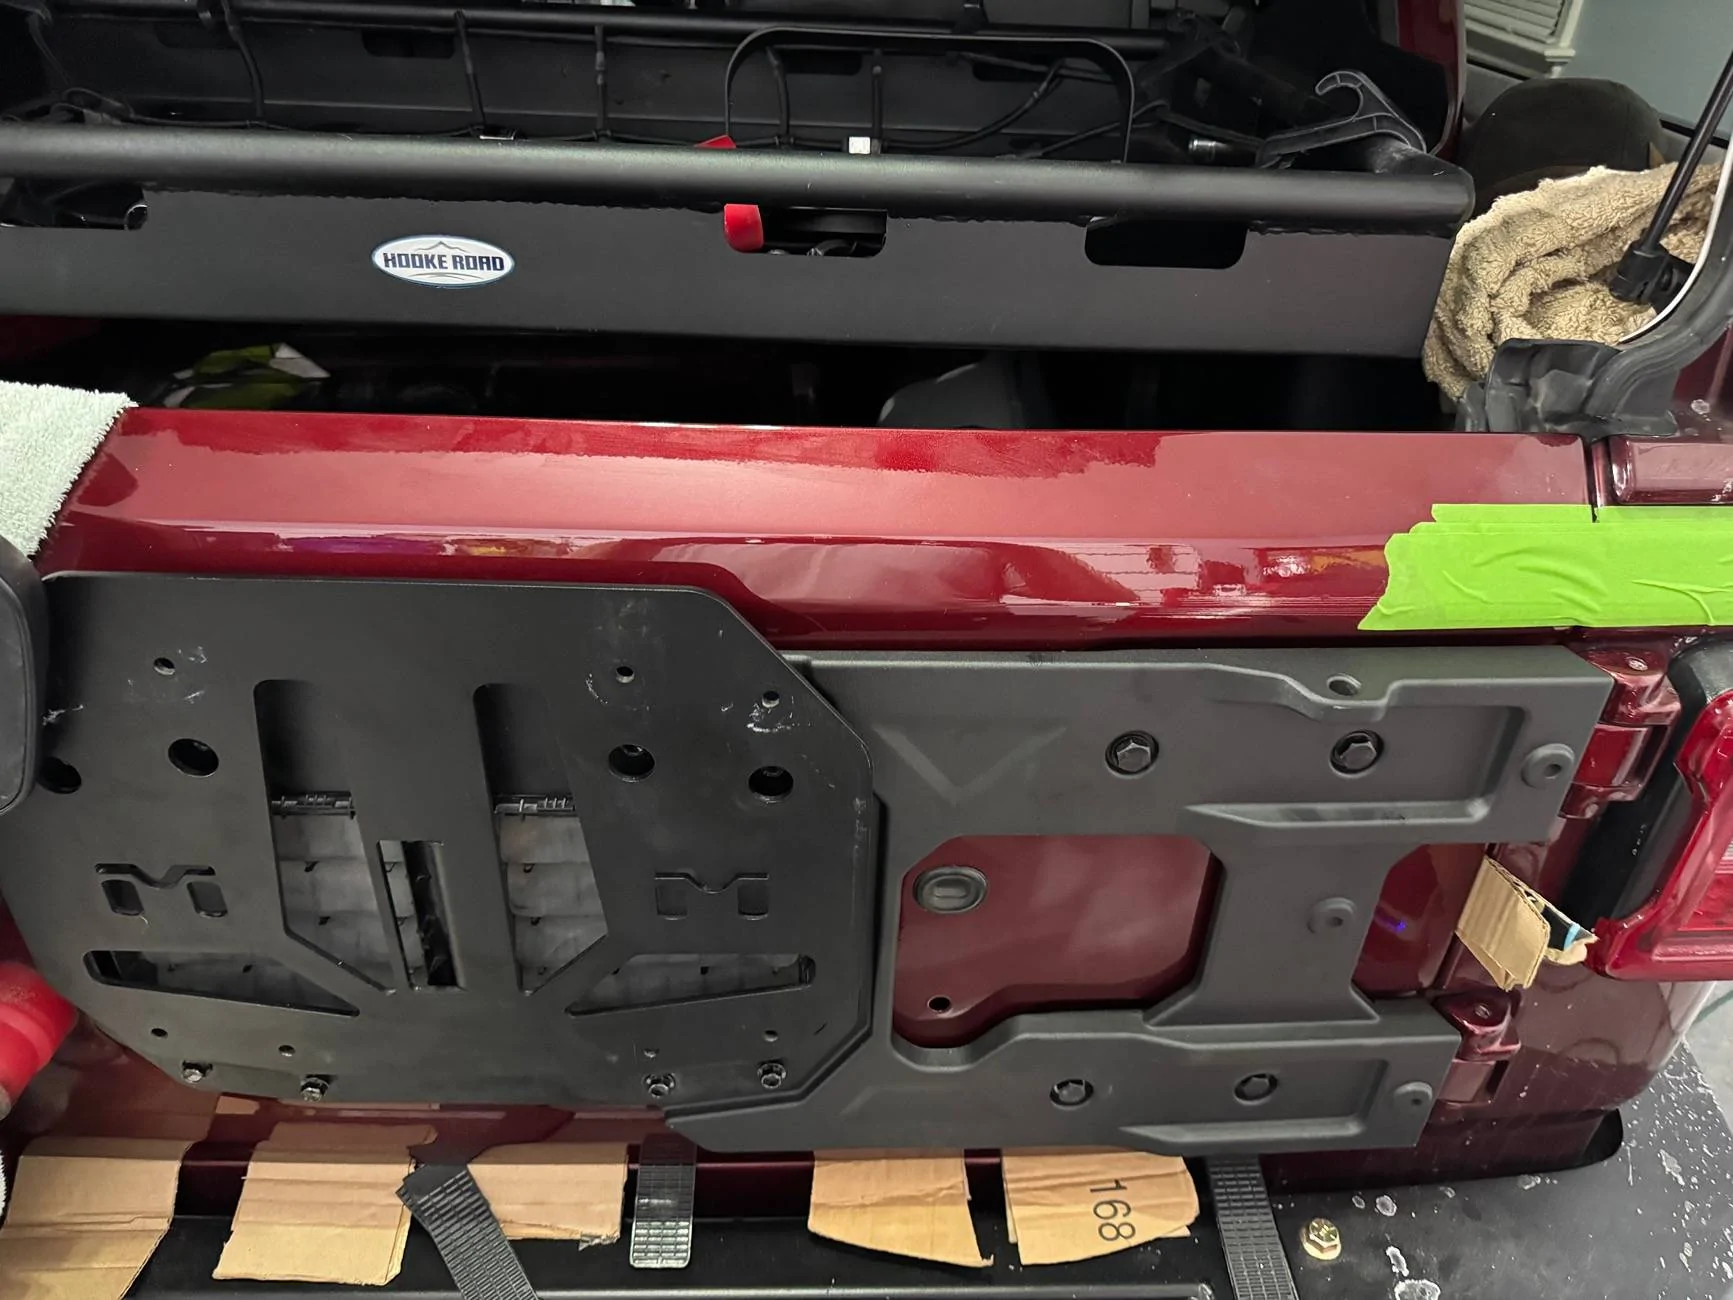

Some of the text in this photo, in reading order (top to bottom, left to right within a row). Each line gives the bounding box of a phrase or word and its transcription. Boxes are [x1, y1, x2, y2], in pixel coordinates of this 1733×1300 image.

[383, 253, 504, 271] HOOKE ROAD
[1090, 1179, 1136, 1241] 168
